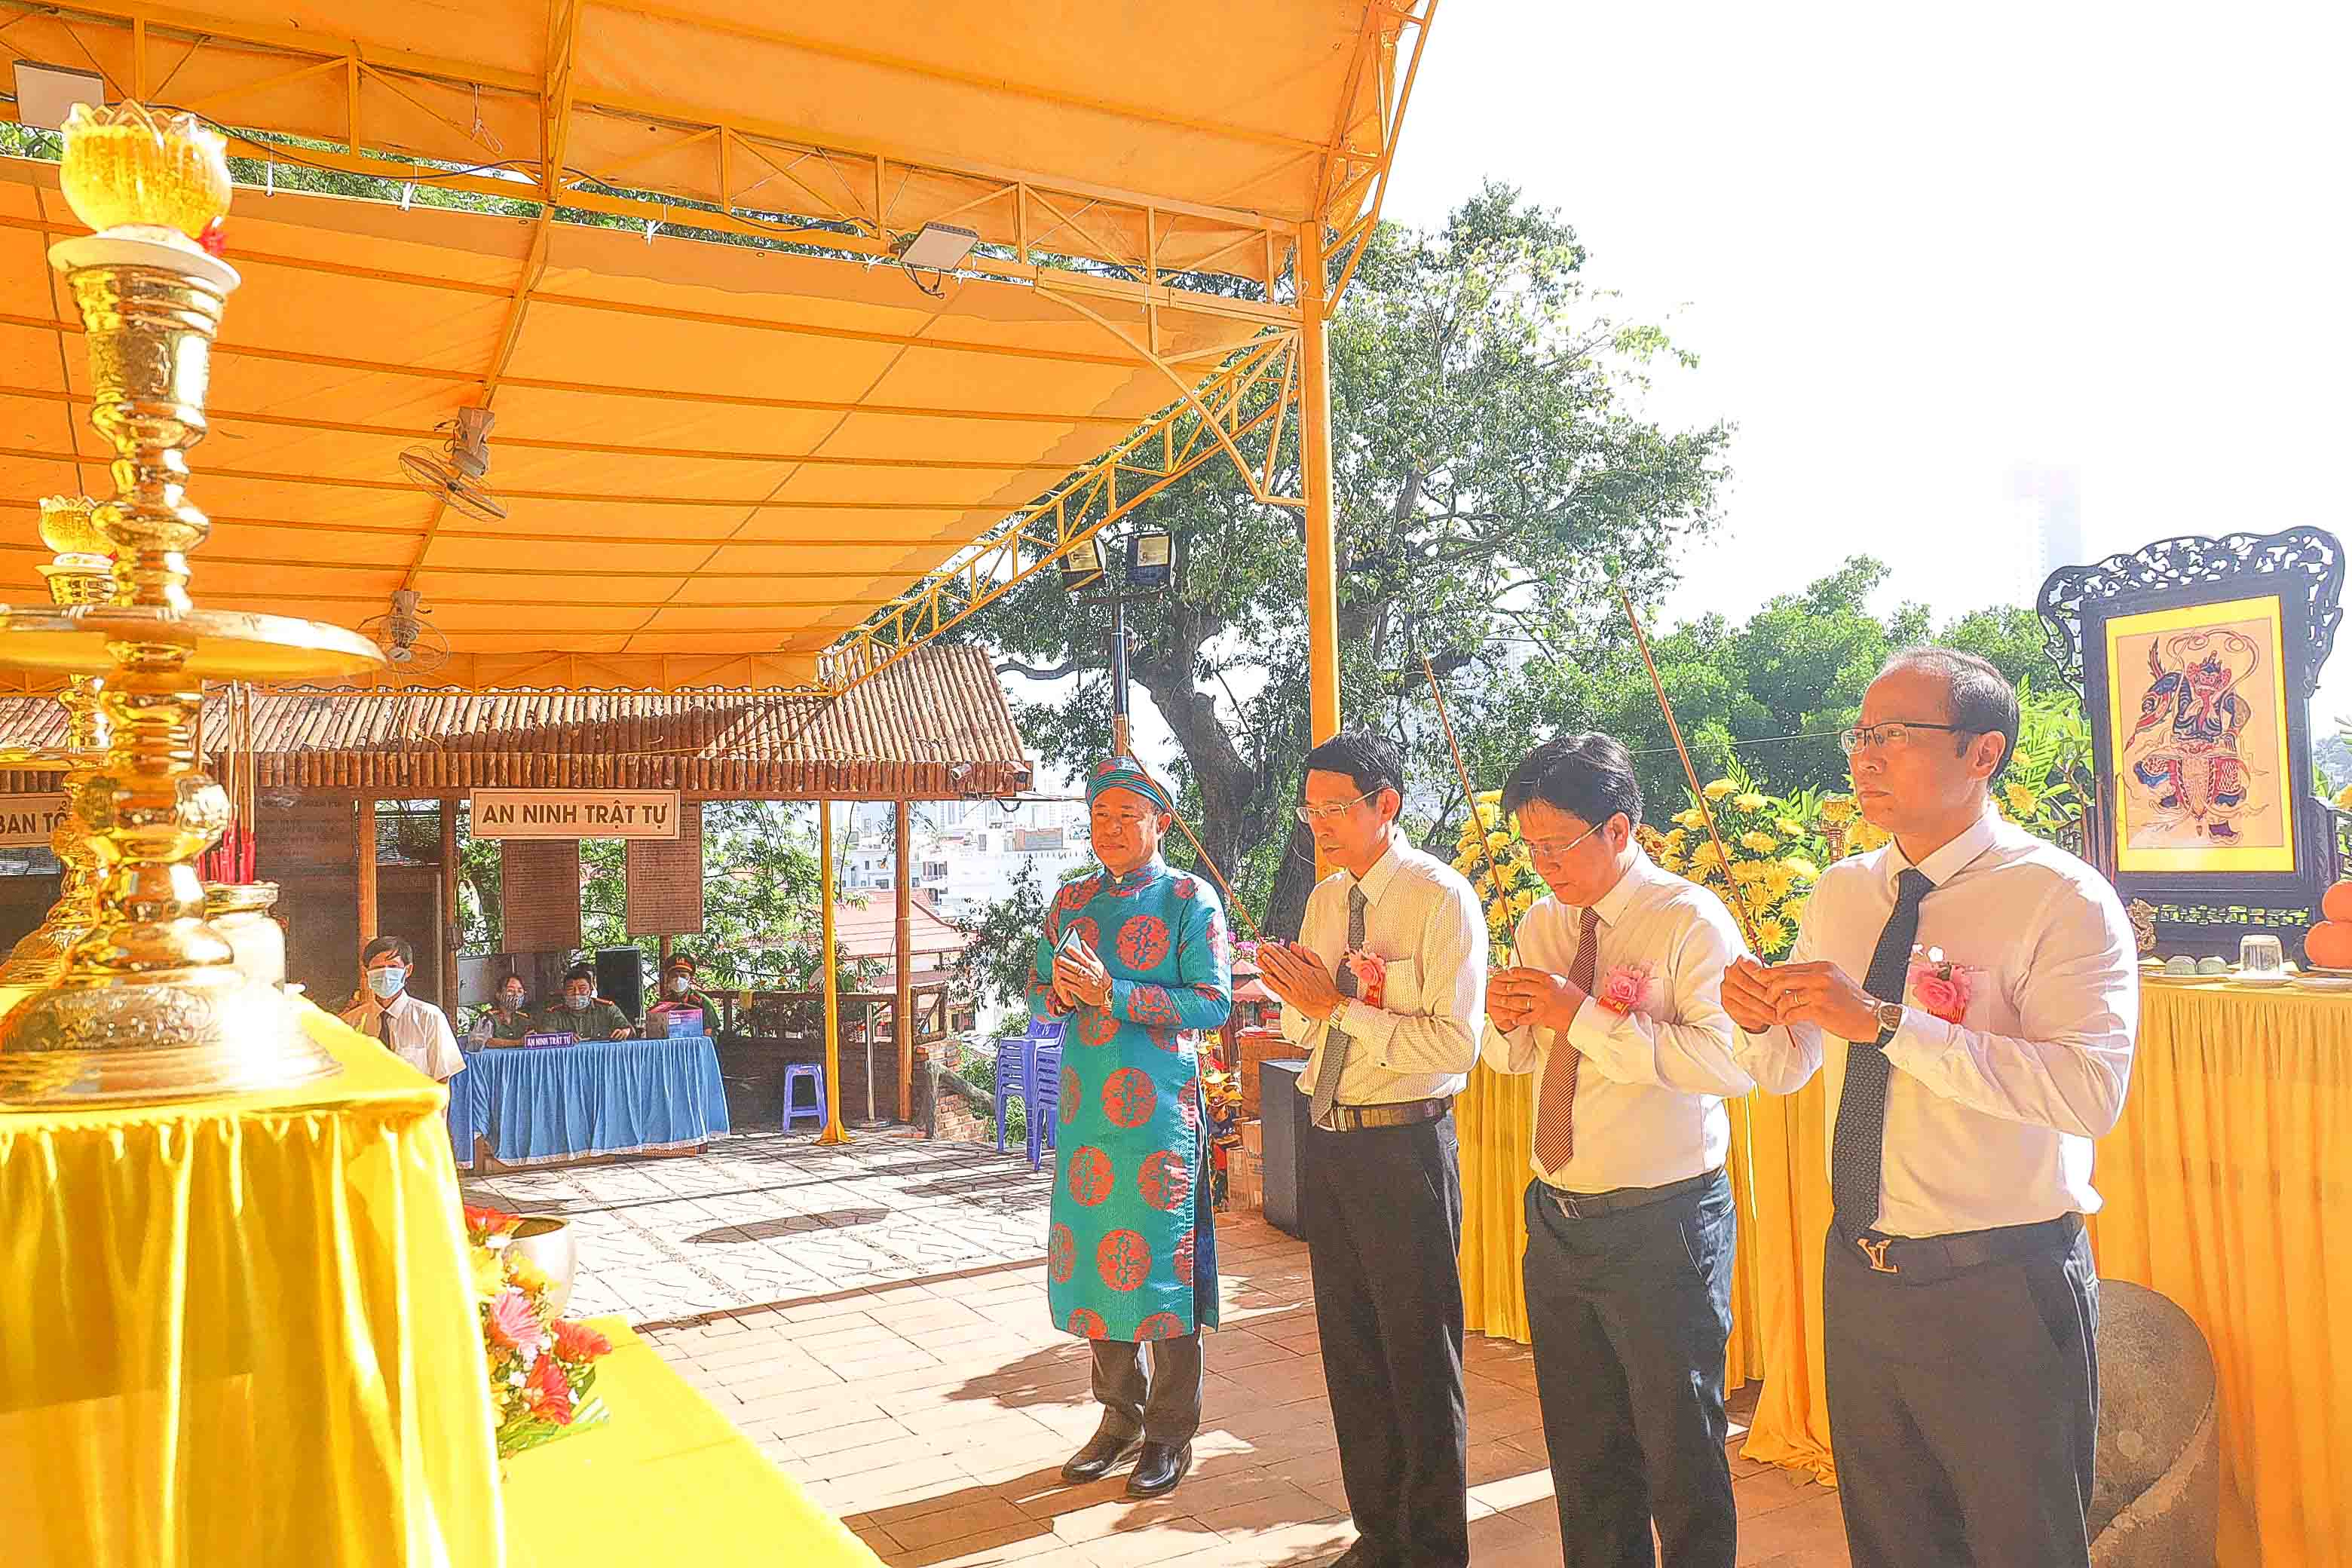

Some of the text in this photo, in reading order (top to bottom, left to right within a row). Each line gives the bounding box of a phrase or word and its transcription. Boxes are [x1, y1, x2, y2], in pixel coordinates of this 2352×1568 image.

[482, 804, 514, 823] AN
[523, 804, 577, 823] NINH
[585, 799, 635, 828] TRẬT
[642, 803, 668, 829] TỰ
